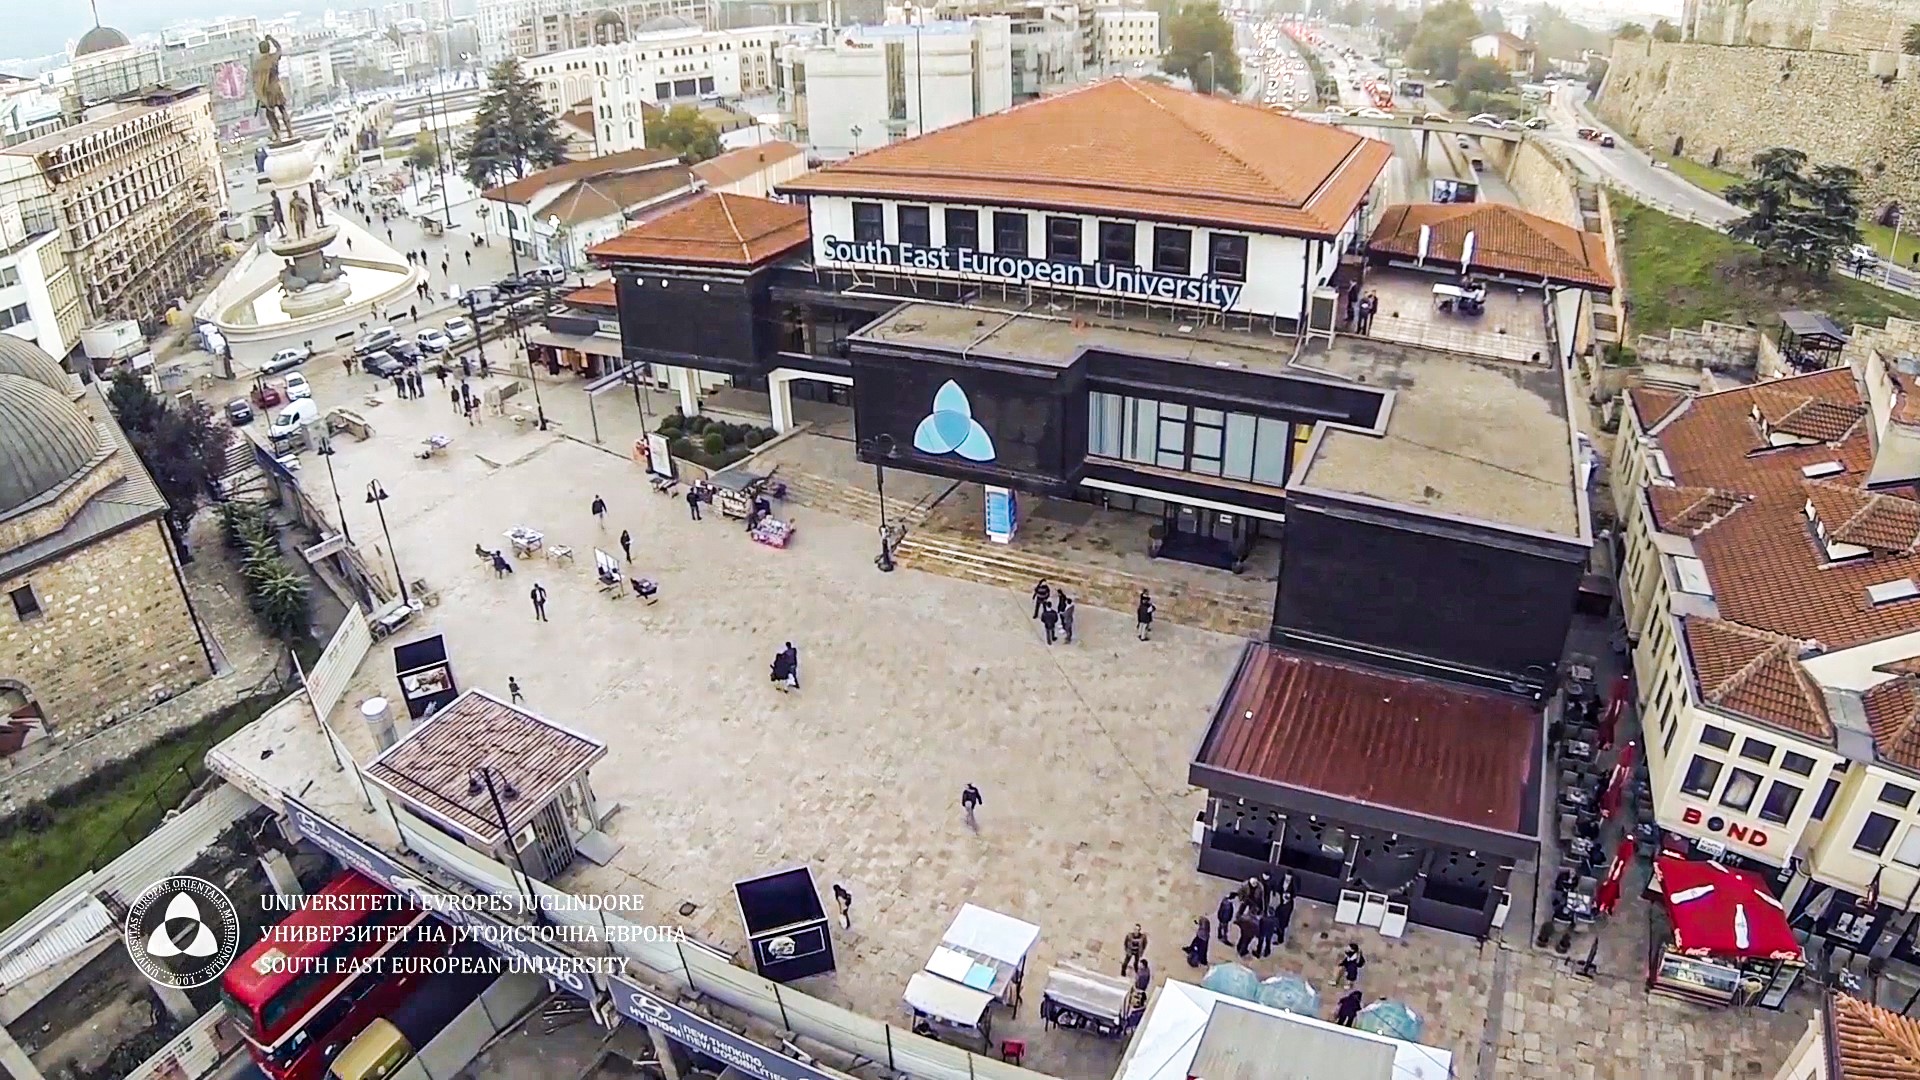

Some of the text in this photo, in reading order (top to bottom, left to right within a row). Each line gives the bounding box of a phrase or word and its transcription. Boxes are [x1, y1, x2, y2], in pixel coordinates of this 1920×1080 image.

[824, 235, 1243, 312] South East European University
[1682, 807, 1768, 847] BOND
[629, 1005, 682, 1037] HYUNDAI
